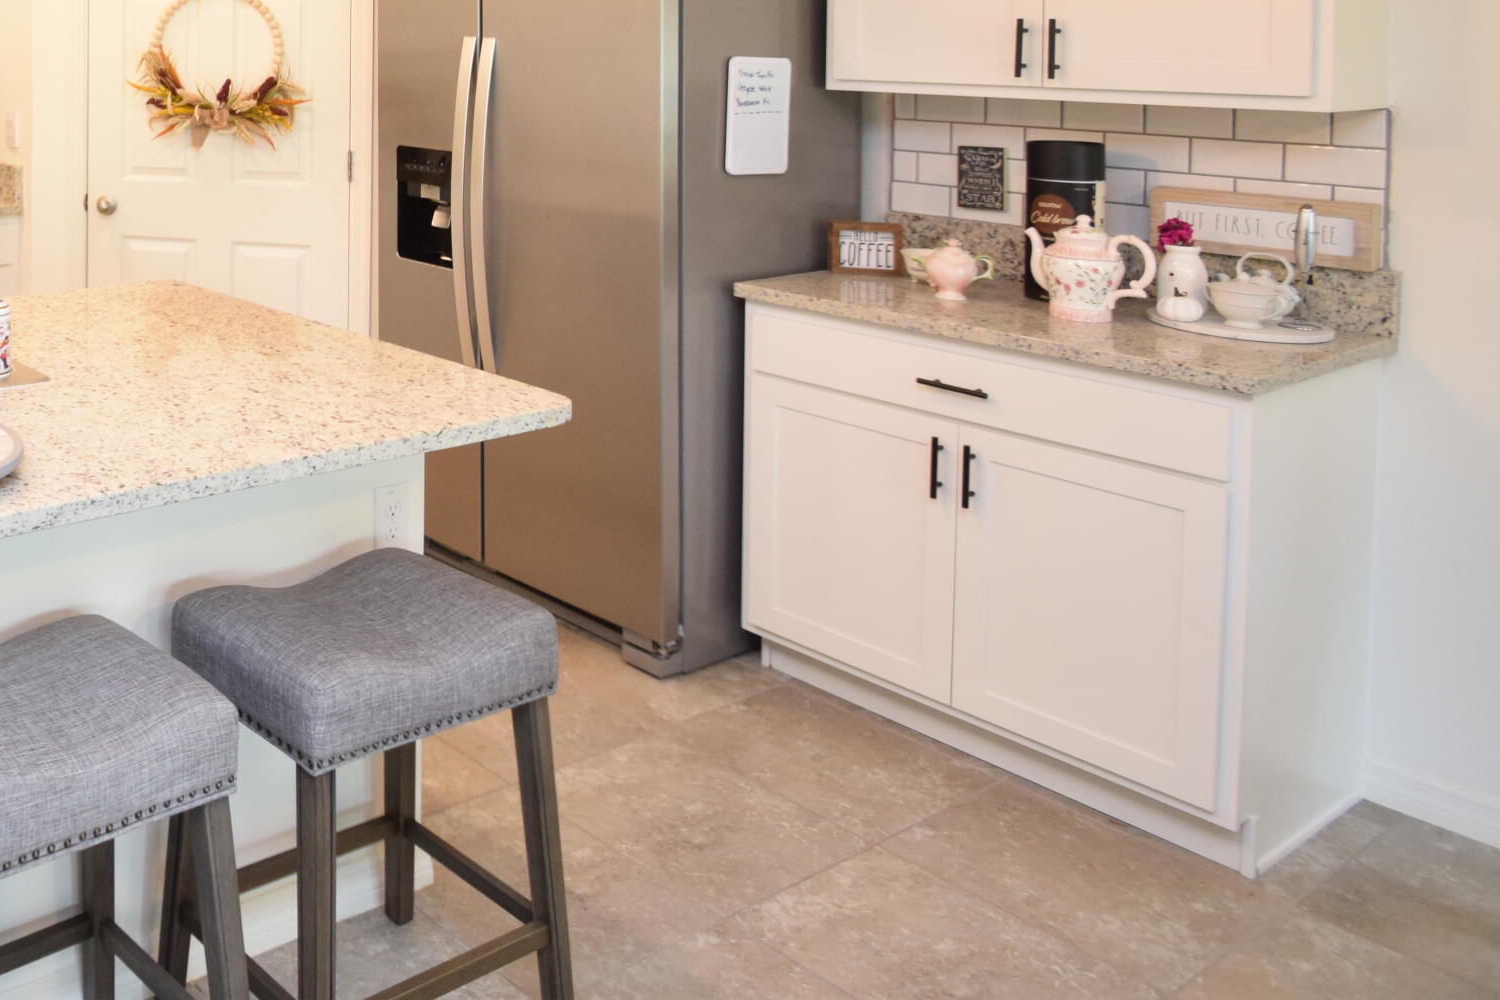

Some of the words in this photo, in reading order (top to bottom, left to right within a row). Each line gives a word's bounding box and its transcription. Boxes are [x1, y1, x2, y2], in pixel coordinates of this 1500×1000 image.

[965, 192, 996, 203] STAR
[1030, 209, 1052, 224] Cold
[1275, 220, 1338, 246] COEE
[838, 240, 894, 268] COFFEE
